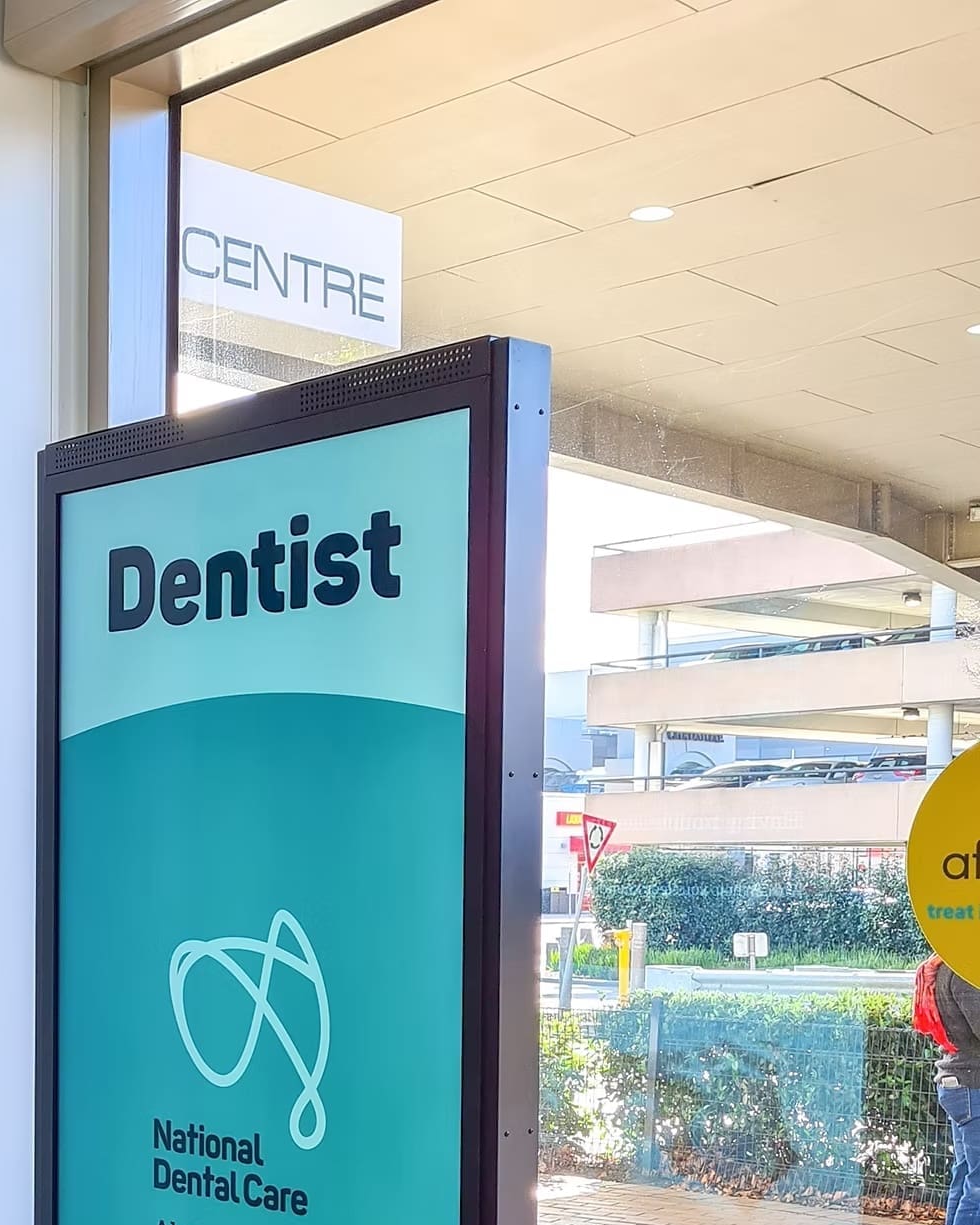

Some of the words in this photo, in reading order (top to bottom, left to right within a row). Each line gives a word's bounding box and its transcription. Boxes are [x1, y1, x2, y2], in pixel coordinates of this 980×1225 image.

[181, 226, 385, 323] CENTRE
[108, 510, 402, 633] Dentist
[927, 904, 974, 920] treat
[153, 1117, 265, 1167] National
[153, 1157, 241, 1204] Dental
[243, 1173, 309, 1217] Care
